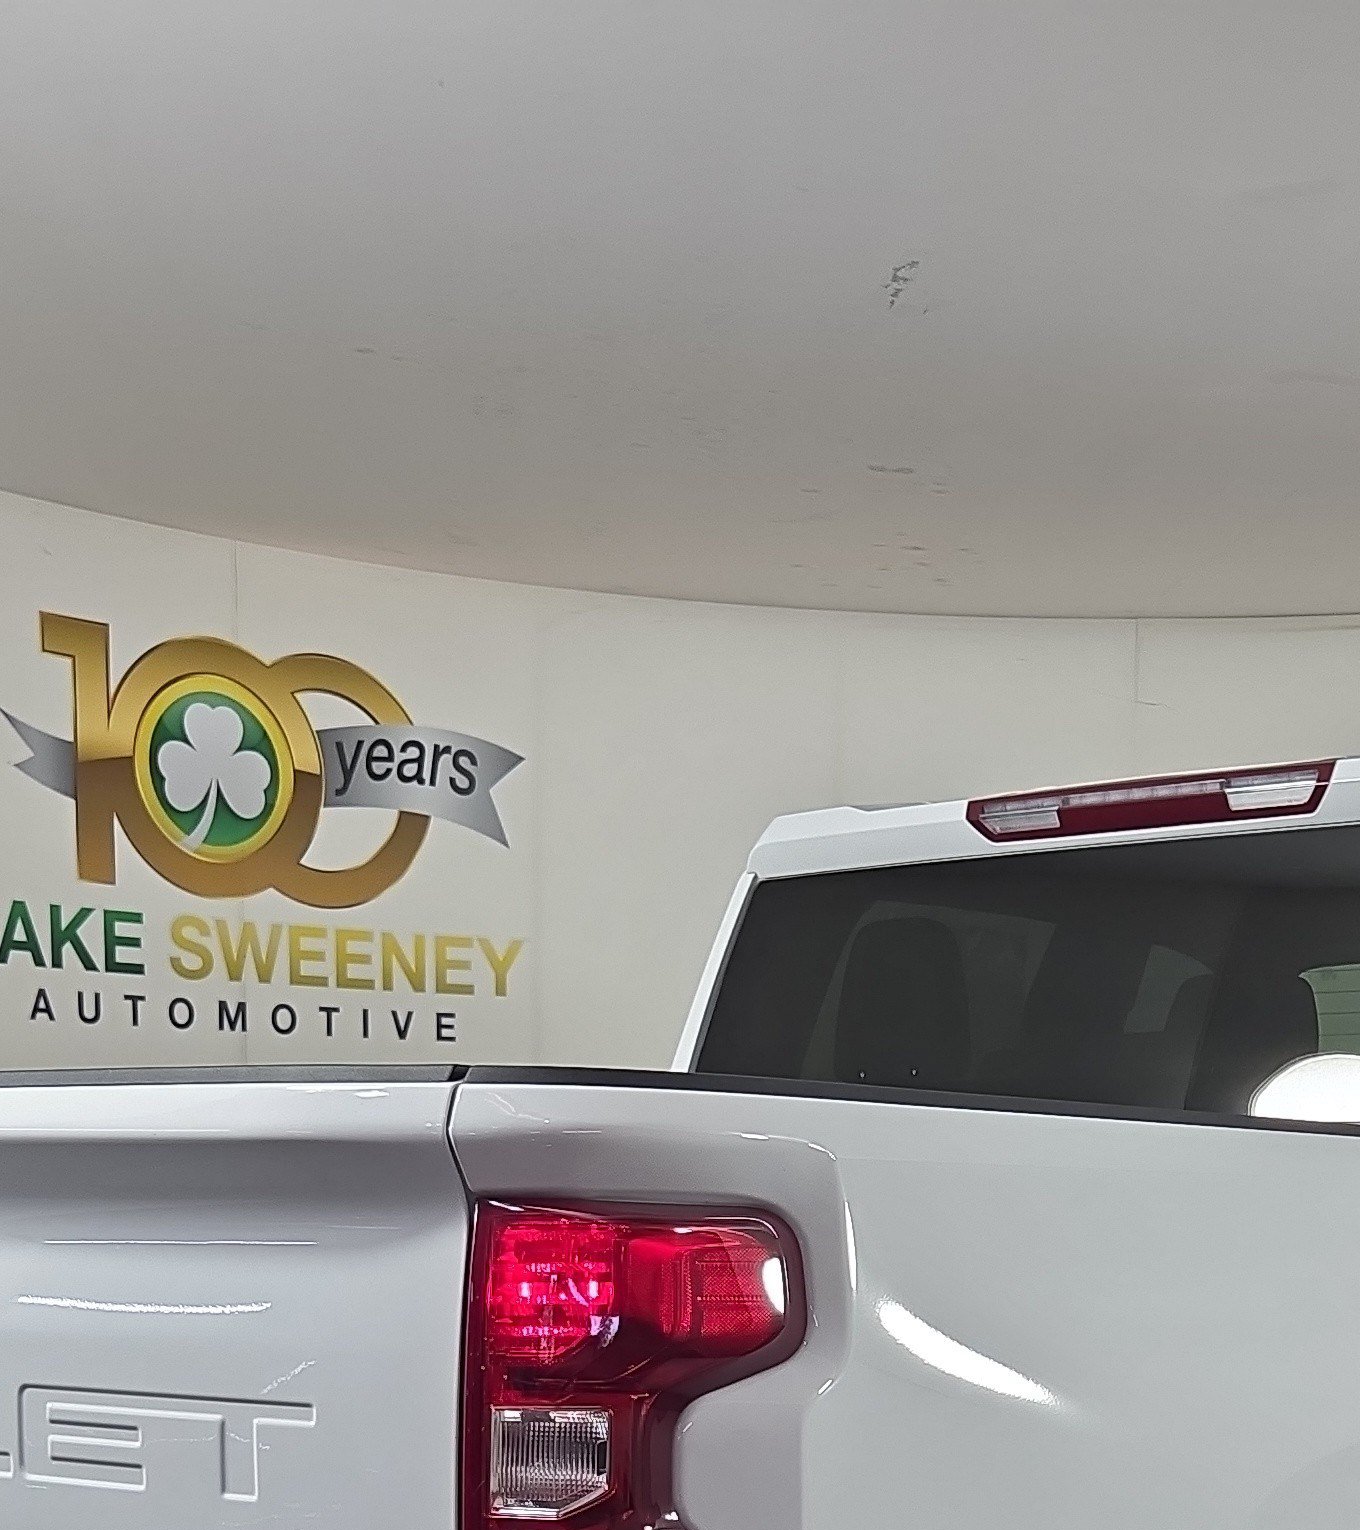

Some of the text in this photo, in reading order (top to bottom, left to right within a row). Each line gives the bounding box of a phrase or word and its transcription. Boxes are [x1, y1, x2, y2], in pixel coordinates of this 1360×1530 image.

[39, 610, 431, 909] 100
[334, 737, 479, 796] years
[169, 913, 524, 997] SWEENEY
[30, 988, 457, 1042] AUTOMOTIVE
